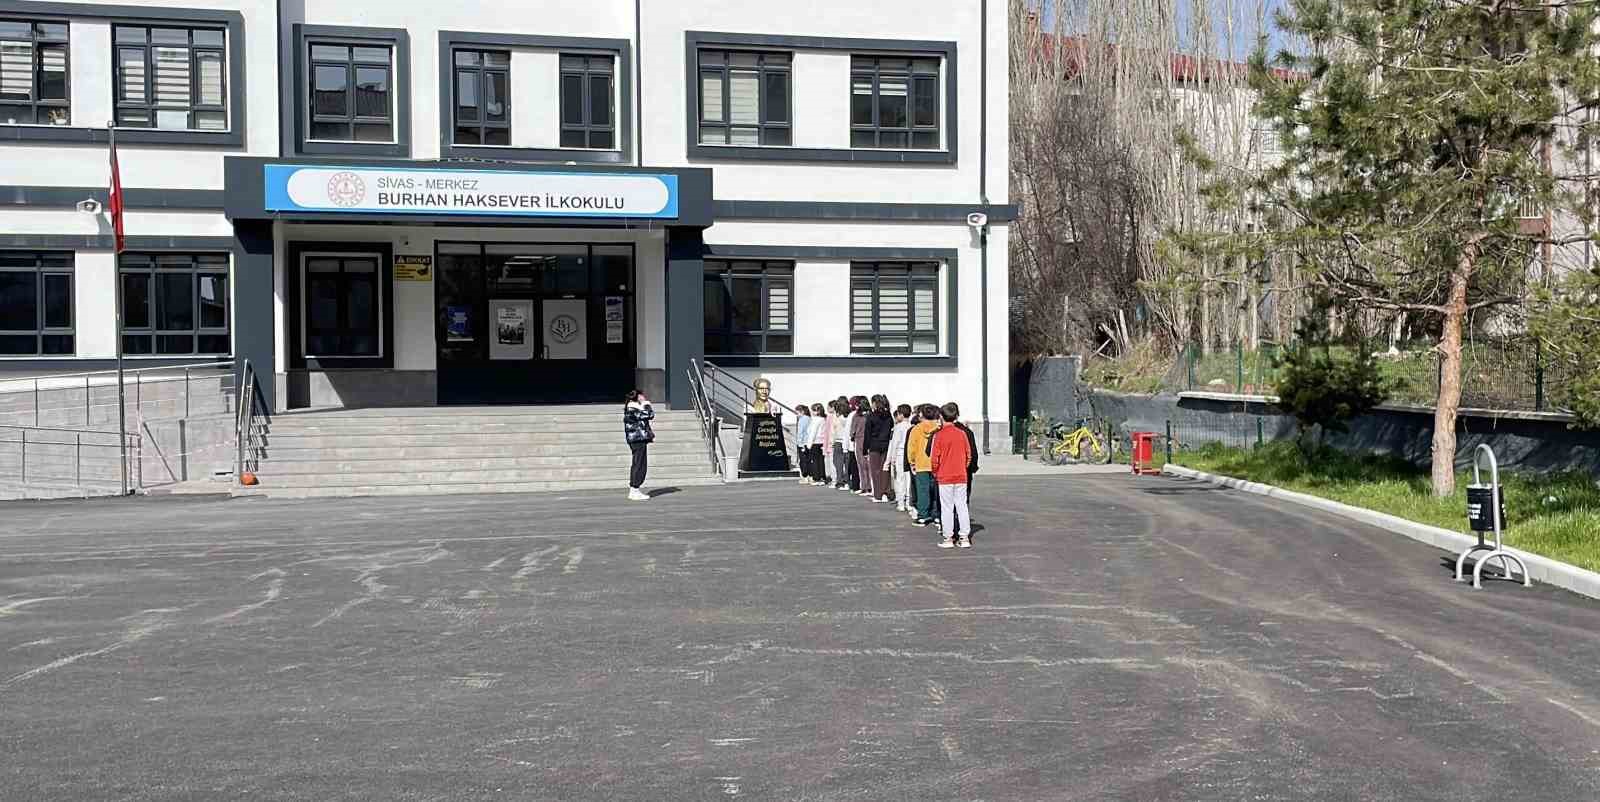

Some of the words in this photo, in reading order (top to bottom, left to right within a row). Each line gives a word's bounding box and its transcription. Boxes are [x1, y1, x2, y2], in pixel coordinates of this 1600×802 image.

[377, 176, 415, 189] SİVAS
[426, 178, 479, 191] MERKEZ
[378, 193, 448, 206] BURHAN
[454, 193, 541, 208] HAKSEVER
[546, 193, 625, 209] İLKOKULU
